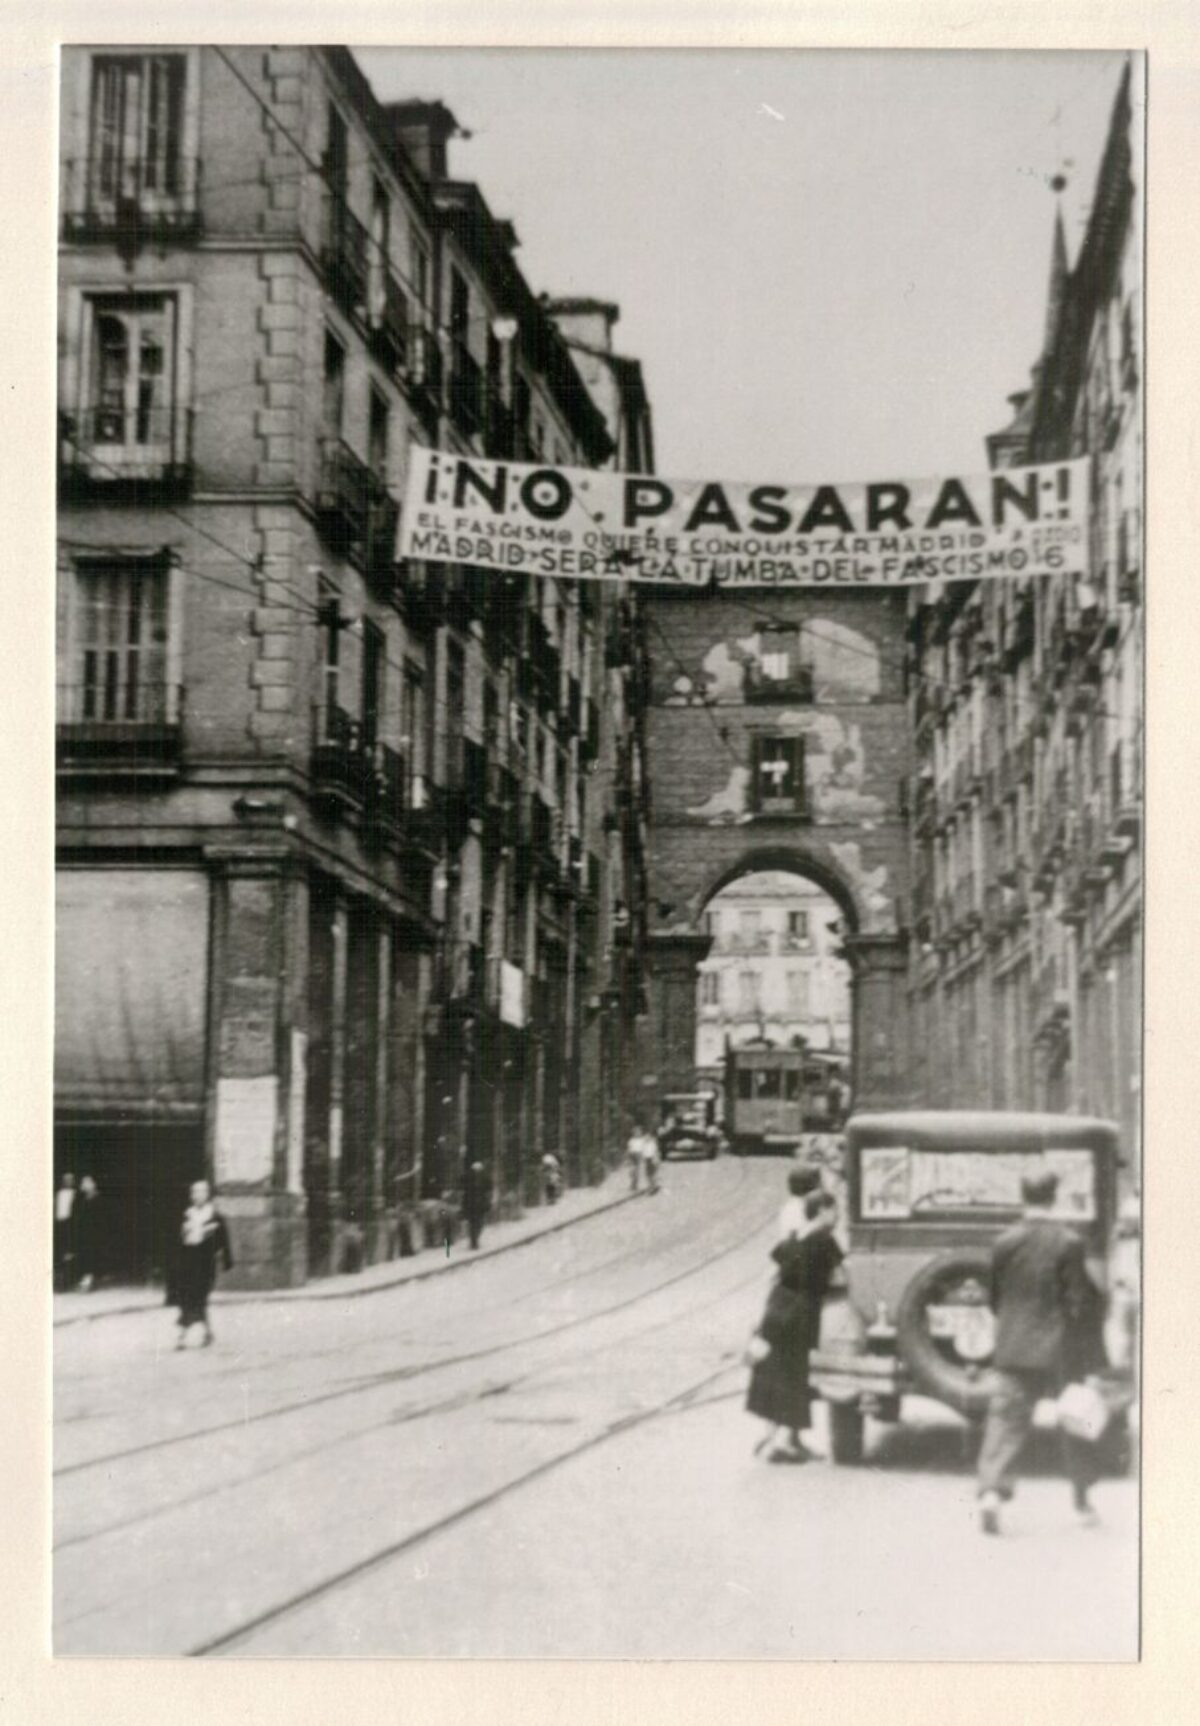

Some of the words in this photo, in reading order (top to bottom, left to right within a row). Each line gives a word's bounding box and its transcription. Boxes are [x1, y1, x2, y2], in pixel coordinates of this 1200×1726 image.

[424, 454, 574, 521] ¡NO
[622, 468, 1070, 534] PASARAN!
[417, 512, 446, 530] EL
[453, 517, 573, 545] FASCISMO
[690, 536, 869, 555] CONQUISTAR
[880, 533, 987, 554] MADRID
